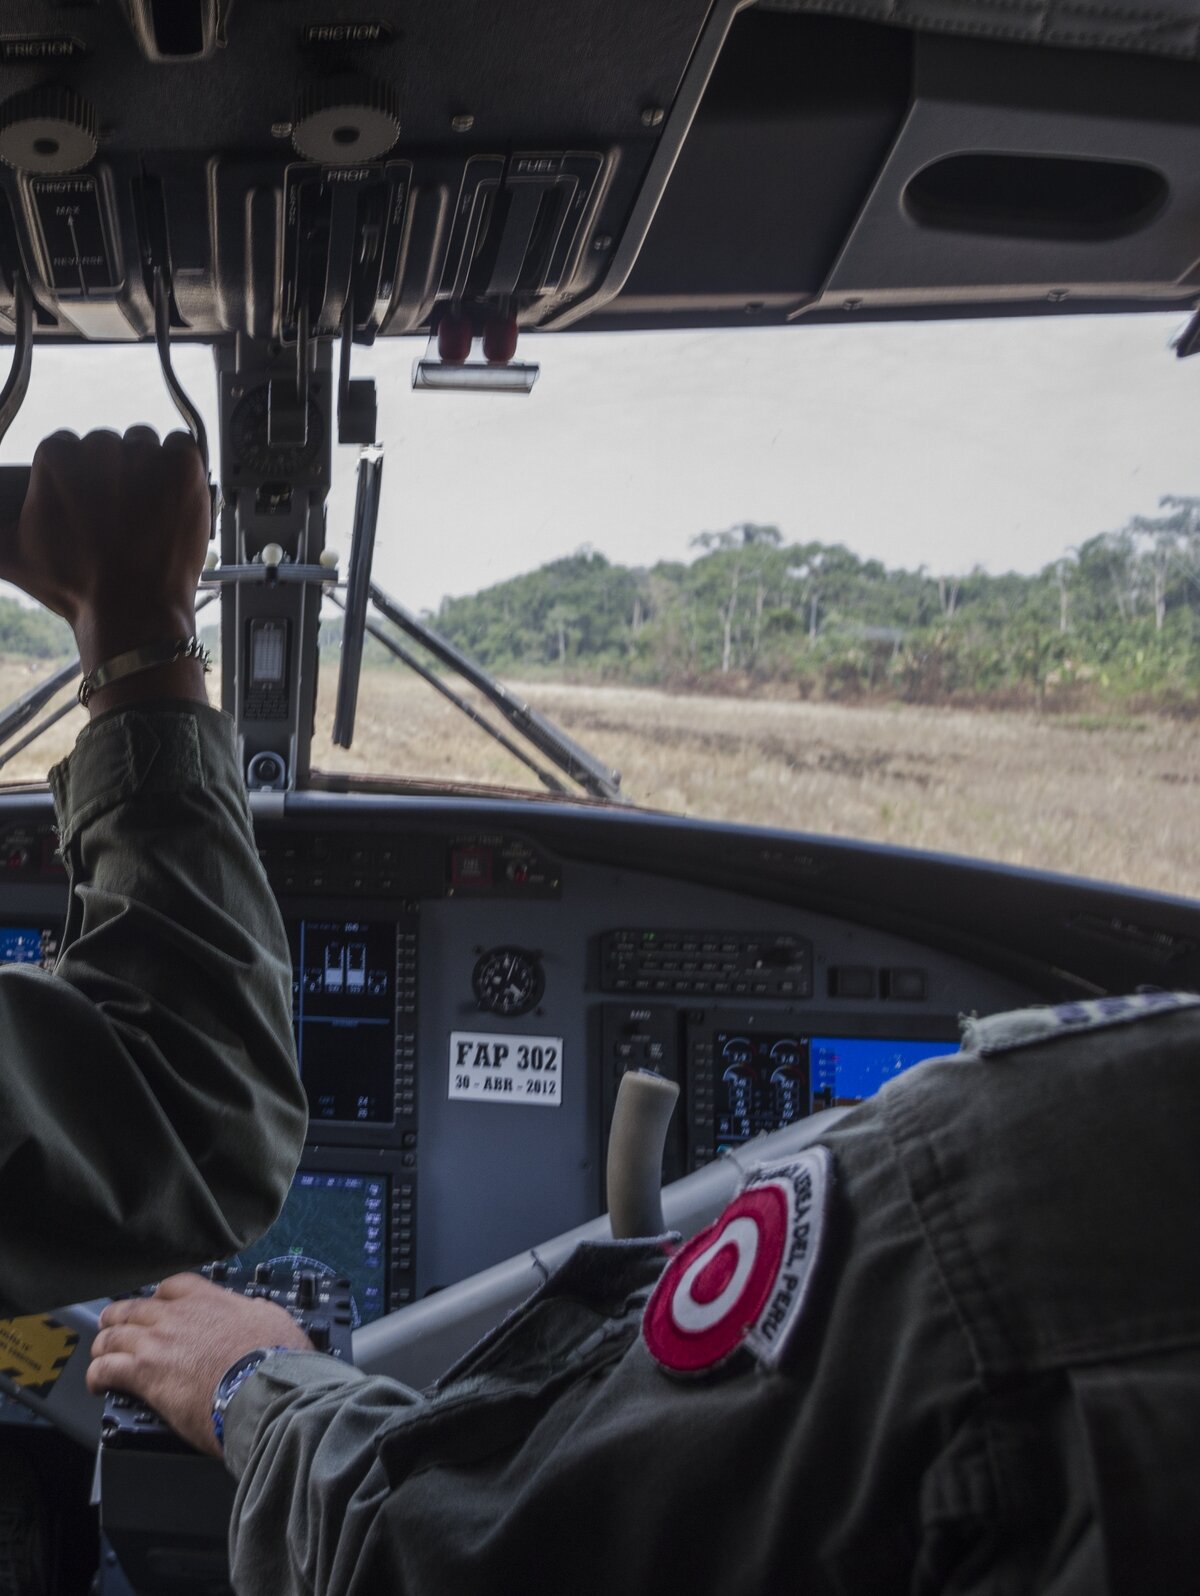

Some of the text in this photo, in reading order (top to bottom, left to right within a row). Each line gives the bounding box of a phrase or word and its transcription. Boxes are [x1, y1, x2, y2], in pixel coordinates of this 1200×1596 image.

[308, 25, 380, 41] FRICTION
[6, 41, 73, 57] FRICTION
[517, 159, 557, 173] FUEL
[326, 169, 370, 183] PROP
[36, 180, 95, 194] THROTTLE
[456, 1041, 557, 1071] FAP 302
[456, 1075, 470, 1089] 30
[483, 1077, 513, 1091] ABR
[526, 1079, 556, 1095] 2012
[786, 1223, 810, 1267] DEL
[762, 1274, 799, 1340] PERU
